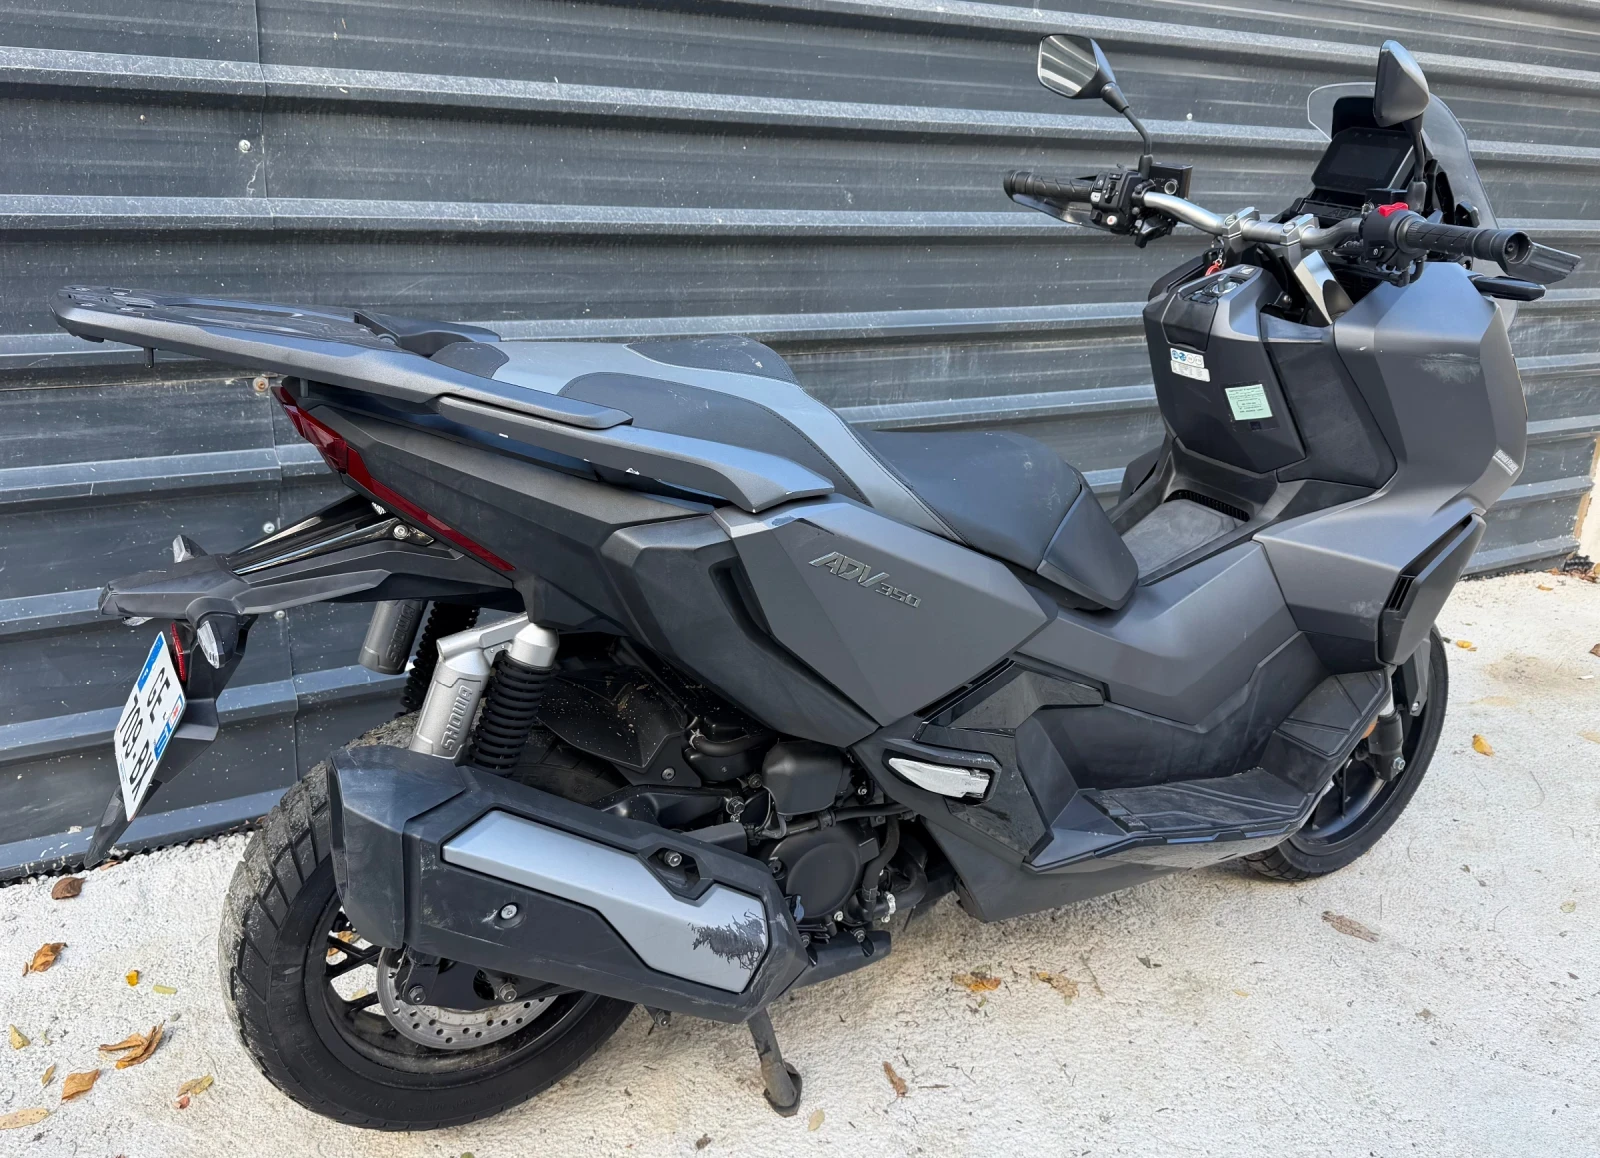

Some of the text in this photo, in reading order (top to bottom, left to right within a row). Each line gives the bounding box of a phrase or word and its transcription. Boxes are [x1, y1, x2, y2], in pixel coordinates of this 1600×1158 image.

[808, 551, 921, 608] ADV 350
[386, 604, 415, 662] SHOWA
[147, 667, 171, 725] GE
[441, 684, 473, 751] SHOWA
